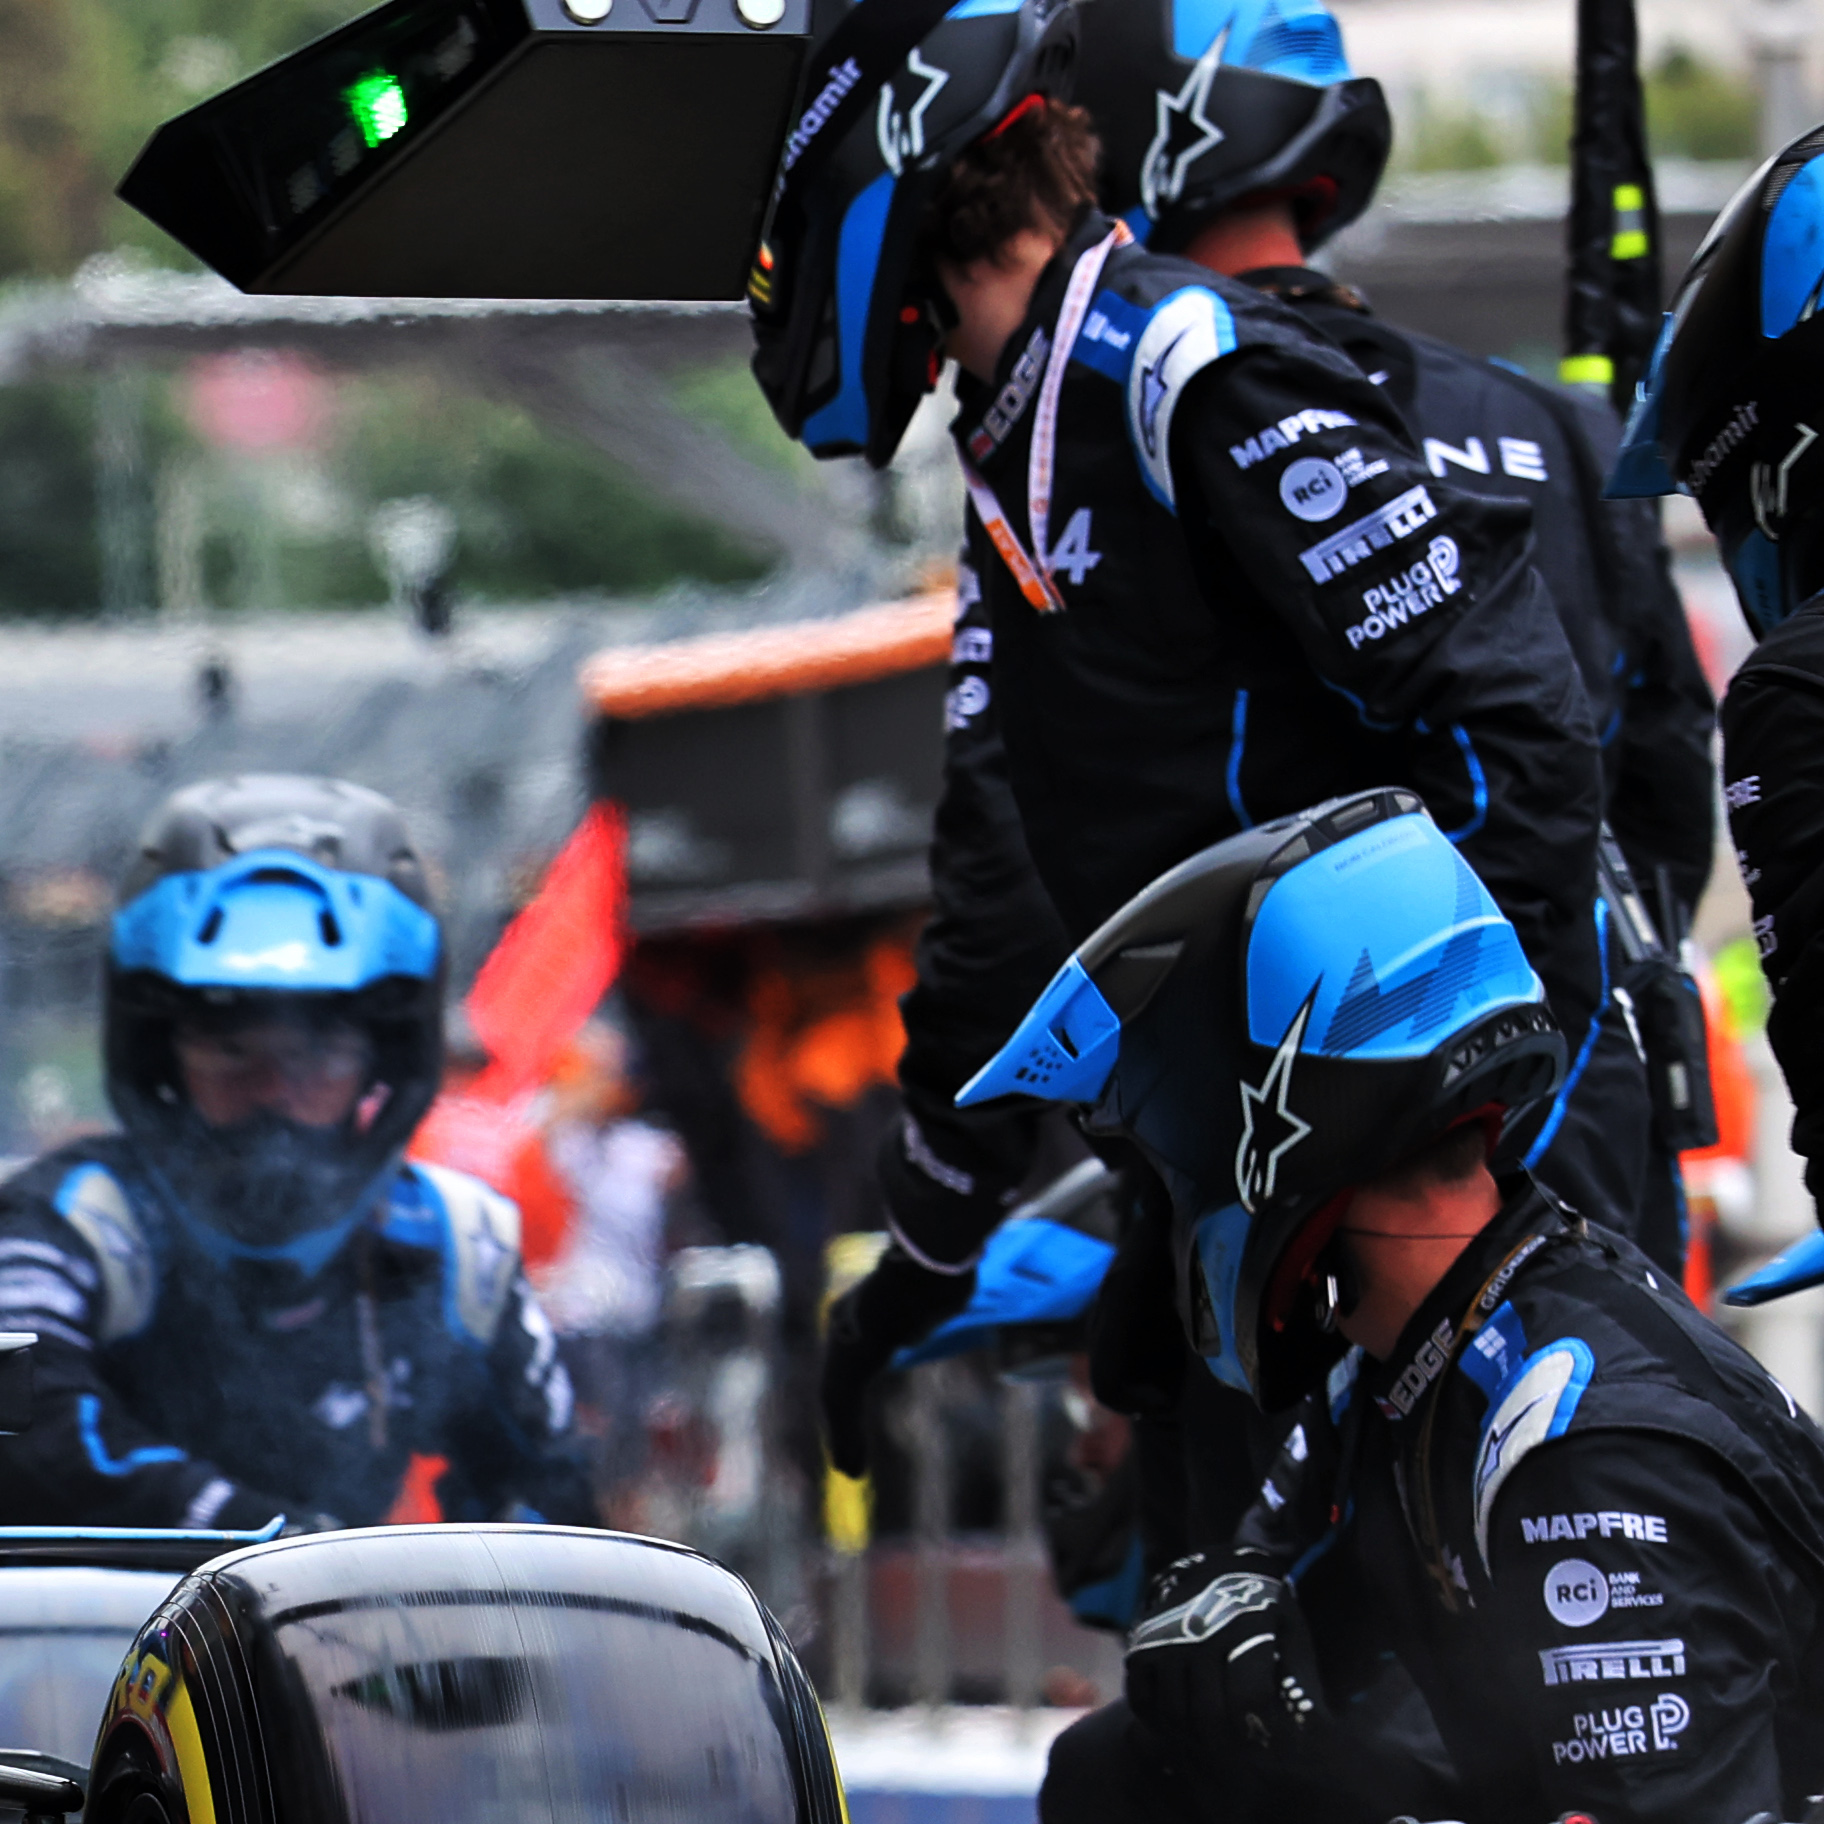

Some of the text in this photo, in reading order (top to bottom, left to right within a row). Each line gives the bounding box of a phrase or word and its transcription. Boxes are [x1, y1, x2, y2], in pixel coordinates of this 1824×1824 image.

[776, 57, 862, 200] hamir
[1298, 483, 1439, 585] PIRELLI
[1362, 561, 1433, 614] PLUG
[1345, 583, 1445, 650] POWER
[1388, 1316, 1456, 1416] EDGE
[1520, 1511, 1668, 1544] MAPFRE
[1556, 1577, 1598, 1604] RCi
[1608, 1571, 1641, 1584] BANK
[1610, 1584, 1636, 1596] AND
[1610, 1593, 1664, 1609] SERVICES
[1538, 1638, 1686, 1687] PIRELLI
[1573, 1705, 1645, 1738] PLUG
[1552, 1730, 1648, 1767] POWER
